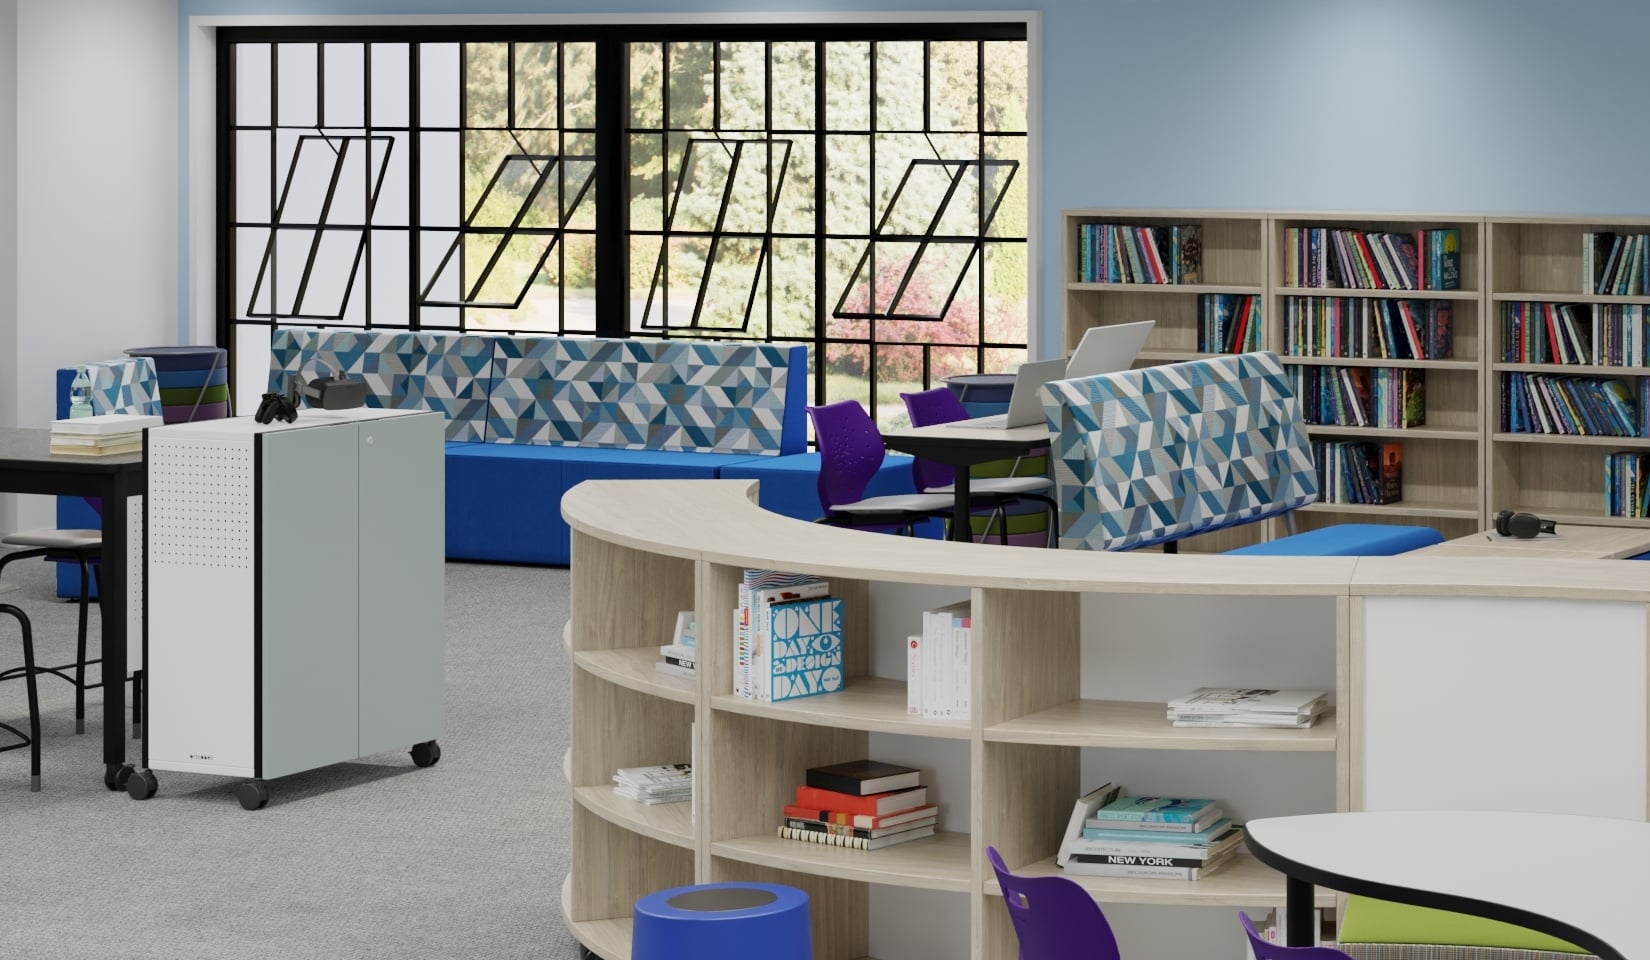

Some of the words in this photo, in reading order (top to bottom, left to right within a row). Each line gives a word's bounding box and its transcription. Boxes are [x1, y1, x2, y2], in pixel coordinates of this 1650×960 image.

[773, 600, 842, 640] ONE
[773, 636, 811, 660] DAY
[785, 651, 841, 673] DESIGN
[773, 669, 823, 700] DAY
[1108, 855, 1136, 865] NEW
[1139, 857, 1173, 866] YORK
